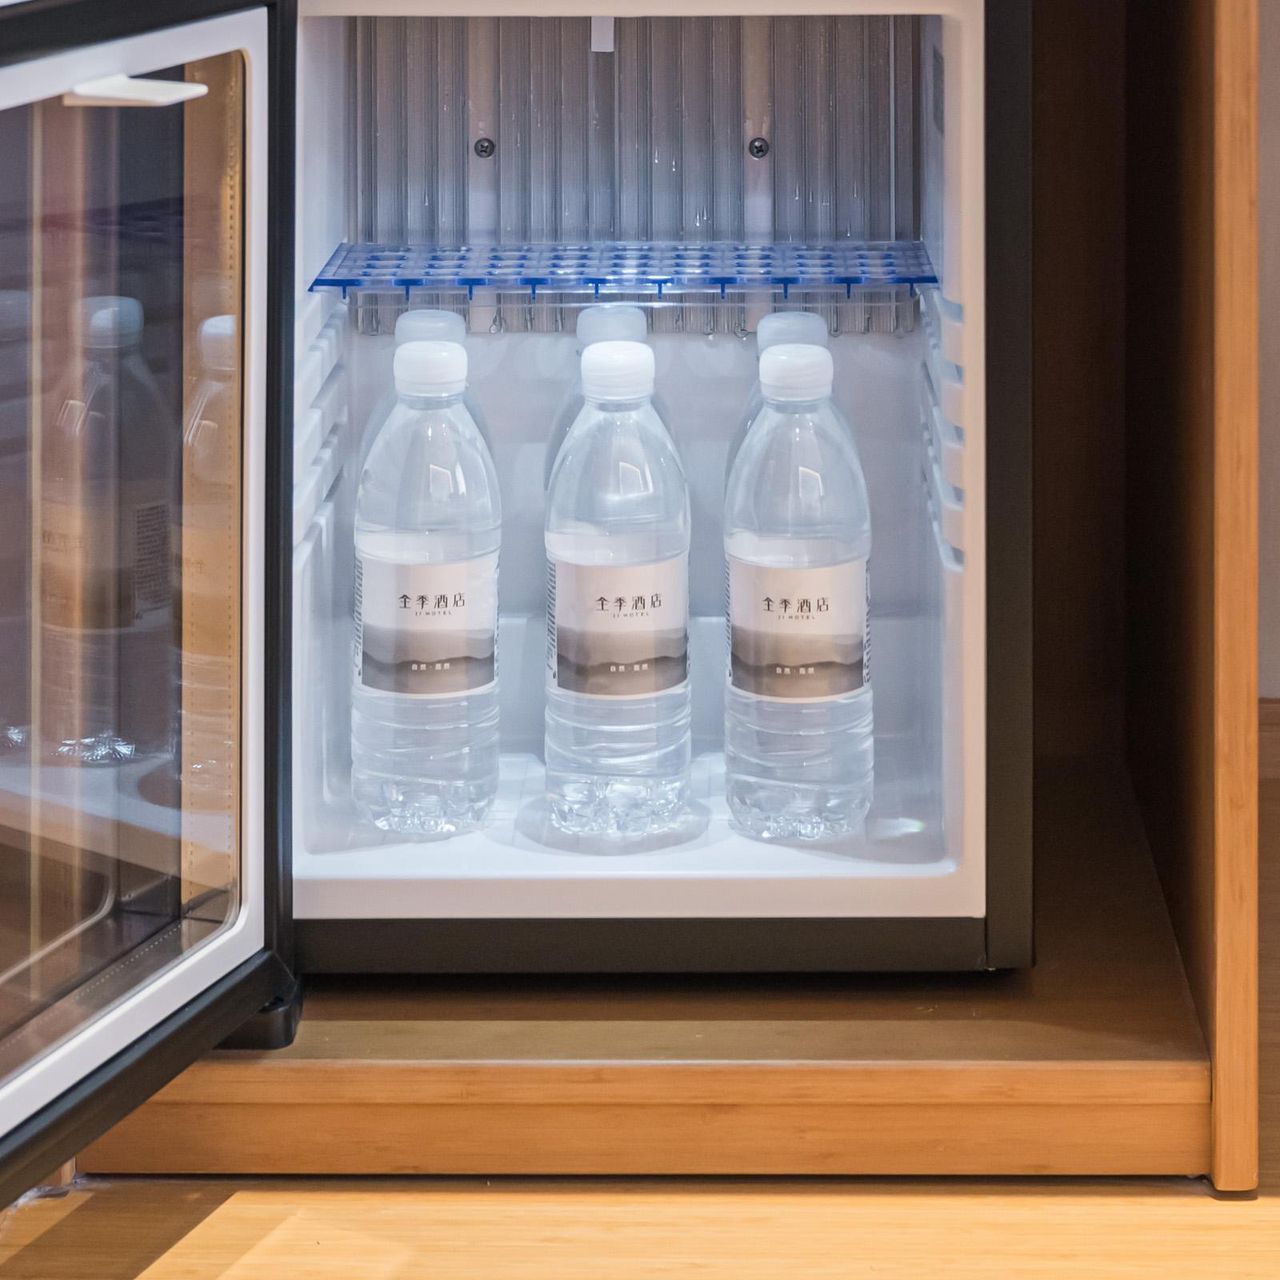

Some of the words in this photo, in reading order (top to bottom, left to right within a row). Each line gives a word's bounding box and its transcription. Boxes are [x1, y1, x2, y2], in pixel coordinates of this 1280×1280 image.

[398, 592, 466, 609] 全季酒店
[595, 593, 662, 612] 全季酒店
[762, 596, 830, 613] 全季酒店
